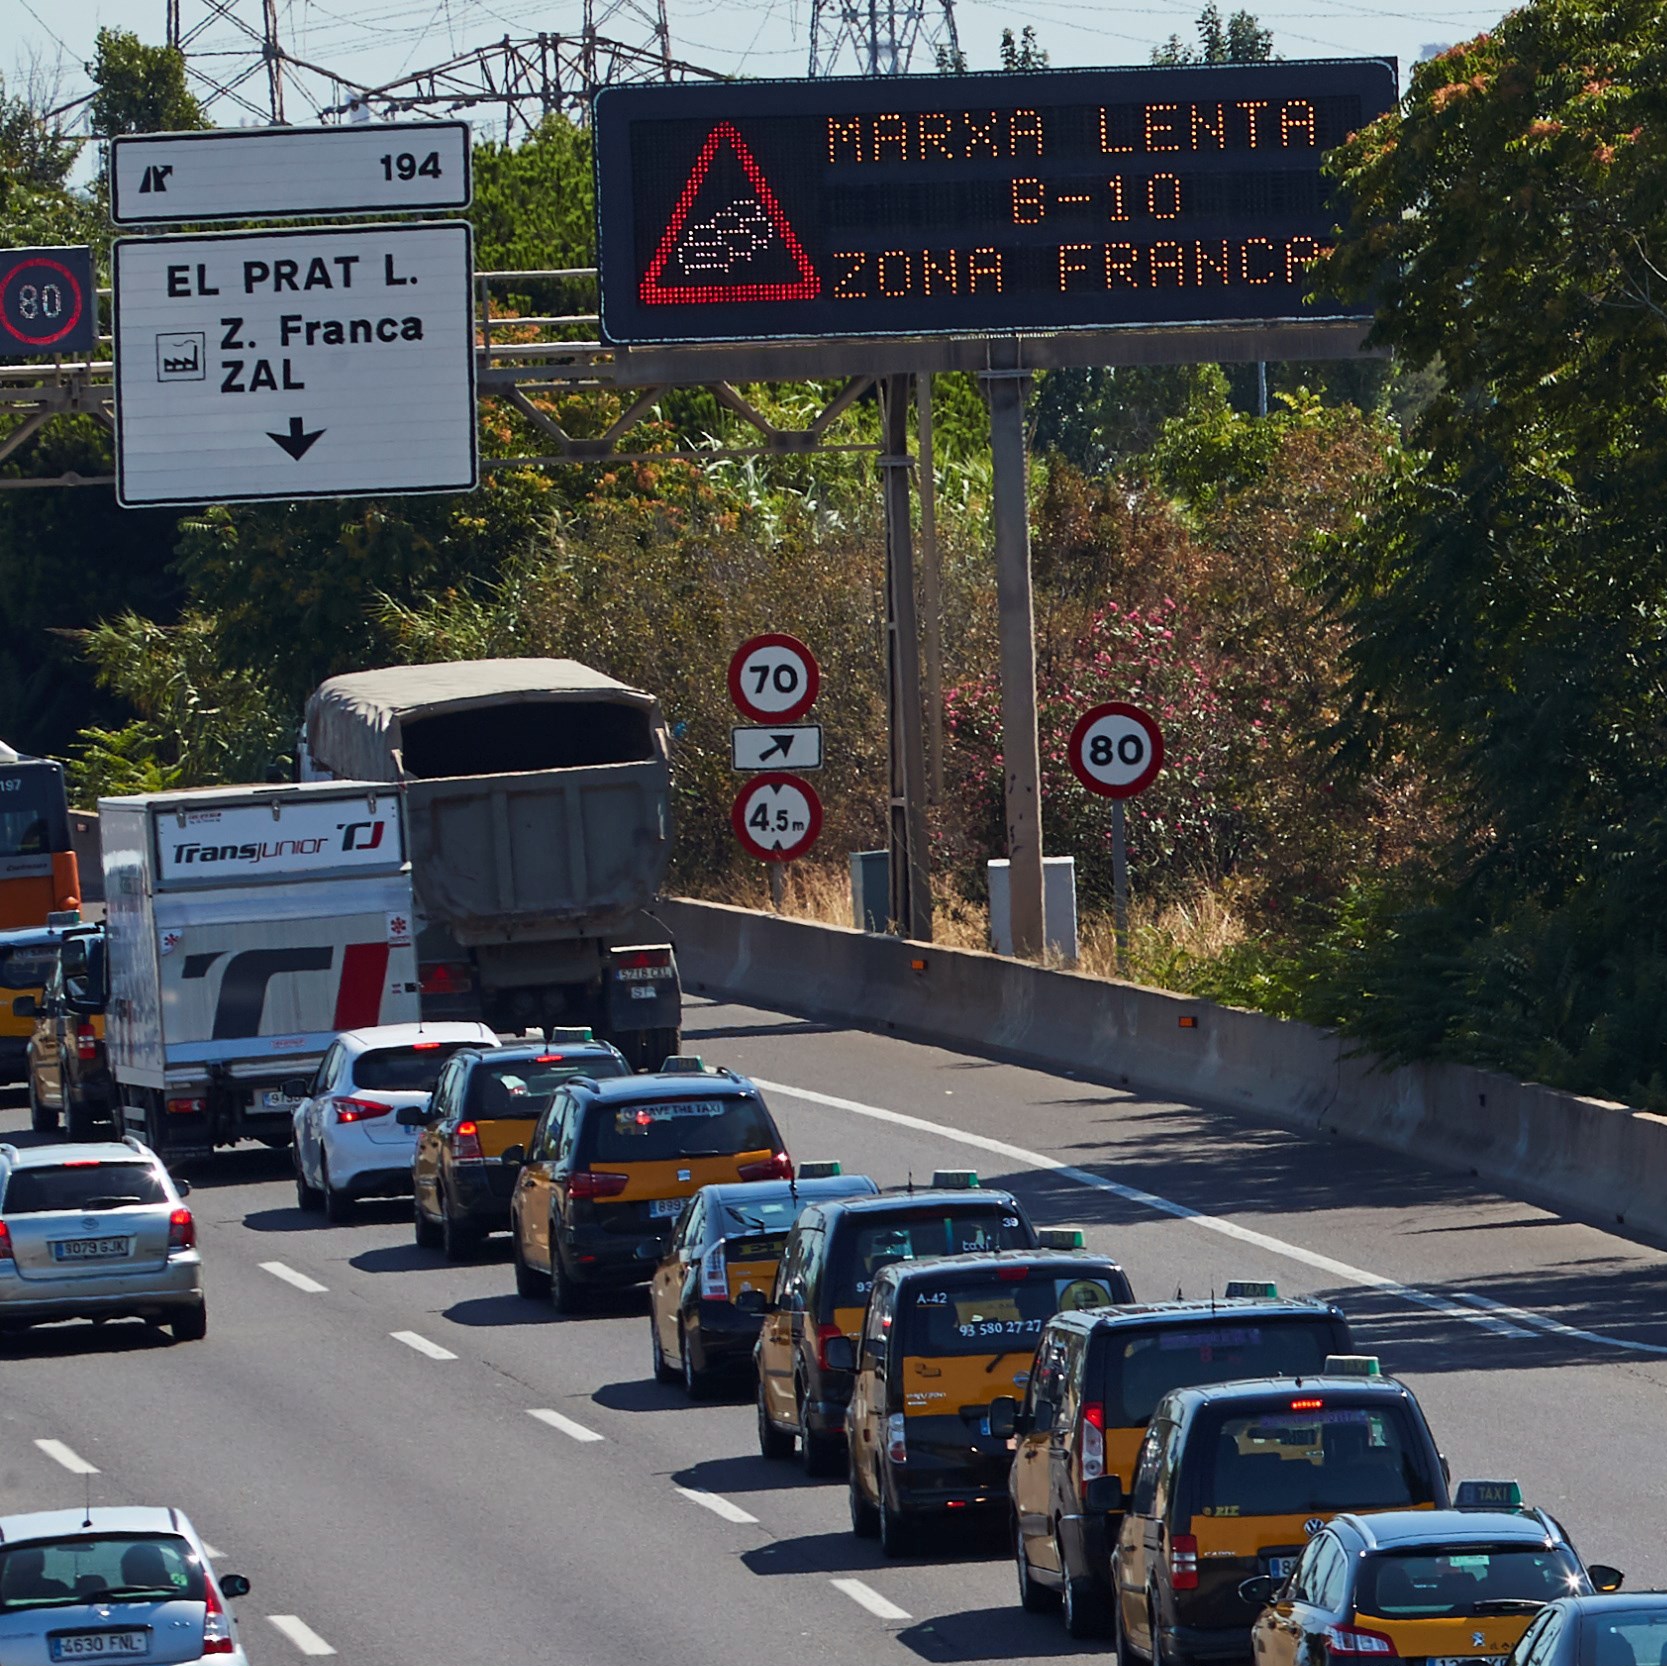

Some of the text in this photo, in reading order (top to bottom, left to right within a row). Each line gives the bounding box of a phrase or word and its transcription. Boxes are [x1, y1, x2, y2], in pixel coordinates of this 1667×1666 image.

[828, 99, 1316, 163] MARXA LENTA
[380, 151, 442, 181] 194
[1011, 172, 1182, 225] B-10
[167, 254, 418, 298] EL PRAT L.
[833, 236, 1321, 299] ZONA FRANCA
[18, 283, 63, 320] 80
[220, 314, 424, 350] Z. Franca
[221, 358, 305, 394] ZAL
[749, 664, 799, 696] 70
[1089, 733, 1144, 767] 80
[696, 1103, 721, 1114] TAXI
[1001, 1217, 1019, 1228] 39
[916, 1292, 948, 1304] A-42
[958, 1319, 1042, 1337] 93 580 27 27
[1478, 1486, 1508, 1501] TAXI
[64, 1635, 140, 1653] 4630 FNL
